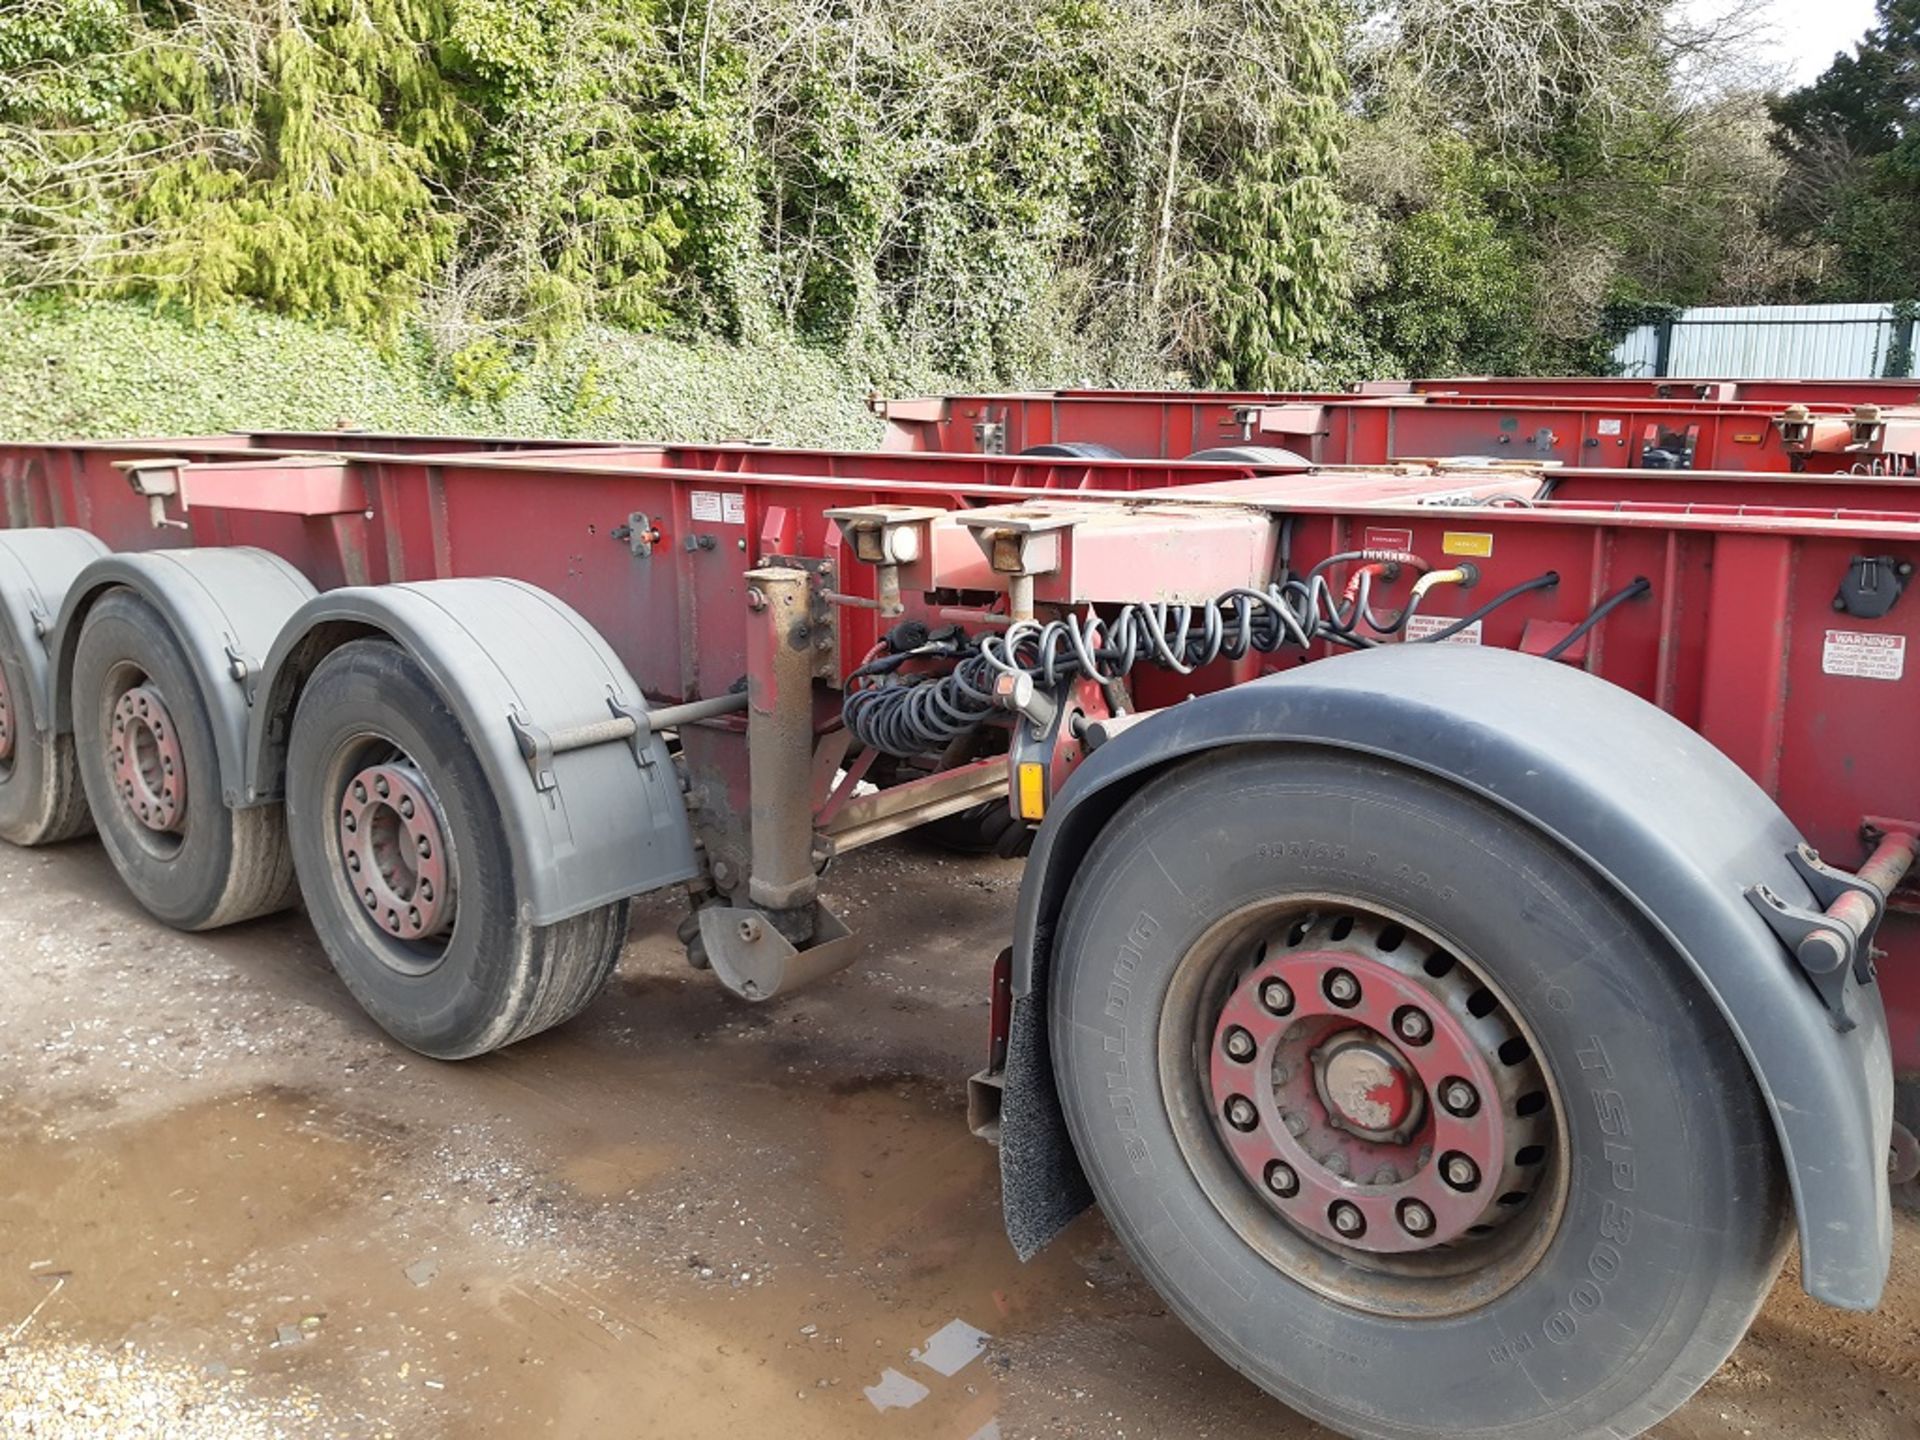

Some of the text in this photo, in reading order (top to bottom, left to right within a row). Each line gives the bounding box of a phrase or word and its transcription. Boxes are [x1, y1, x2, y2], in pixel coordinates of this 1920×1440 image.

[1837, 634, 1895, 648] WARNING
[1102, 910, 1163, 1176] BULLDOG
[1542, 1034, 1637, 1346] TSP 3000
